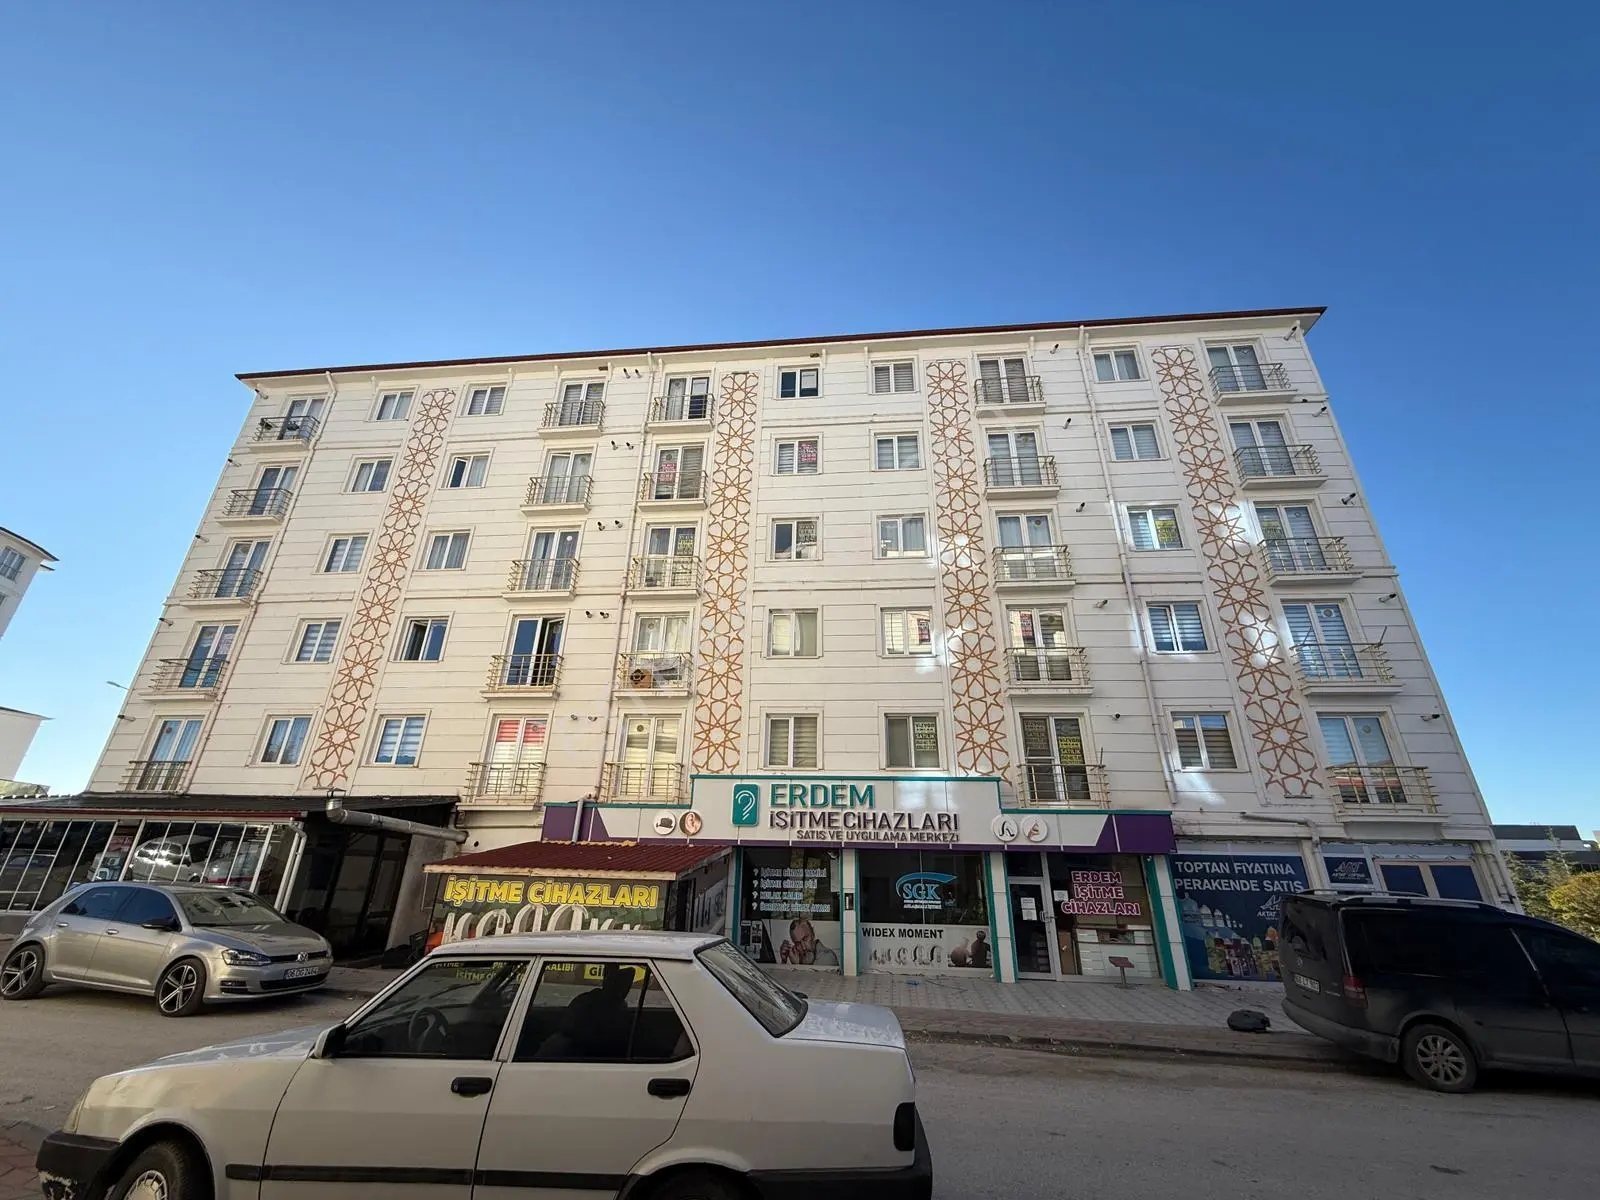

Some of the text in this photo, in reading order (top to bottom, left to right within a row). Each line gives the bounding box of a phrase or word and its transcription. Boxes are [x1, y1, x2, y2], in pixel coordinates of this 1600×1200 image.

[770, 783, 875, 809] ERDEM
[828, 831, 843, 841] VE
[846, 831, 908, 842] UYGULAMA
[1175, 861, 1230, 874] TOPTAN
[1071, 871, 1122, 884] ERDEM
[1174, 878, 1260, 891] PERAKENDE
[444, 875, 659, 909] İŞİTME CİHAZLARI
[902, 882, 941, 900] SGK
[1073, 884, 1125, 901] İŞİTME
[1060, 898, 1141, 916] CİHAZLARI
[862, 927, 944, 939] WIDEX MOMENT
